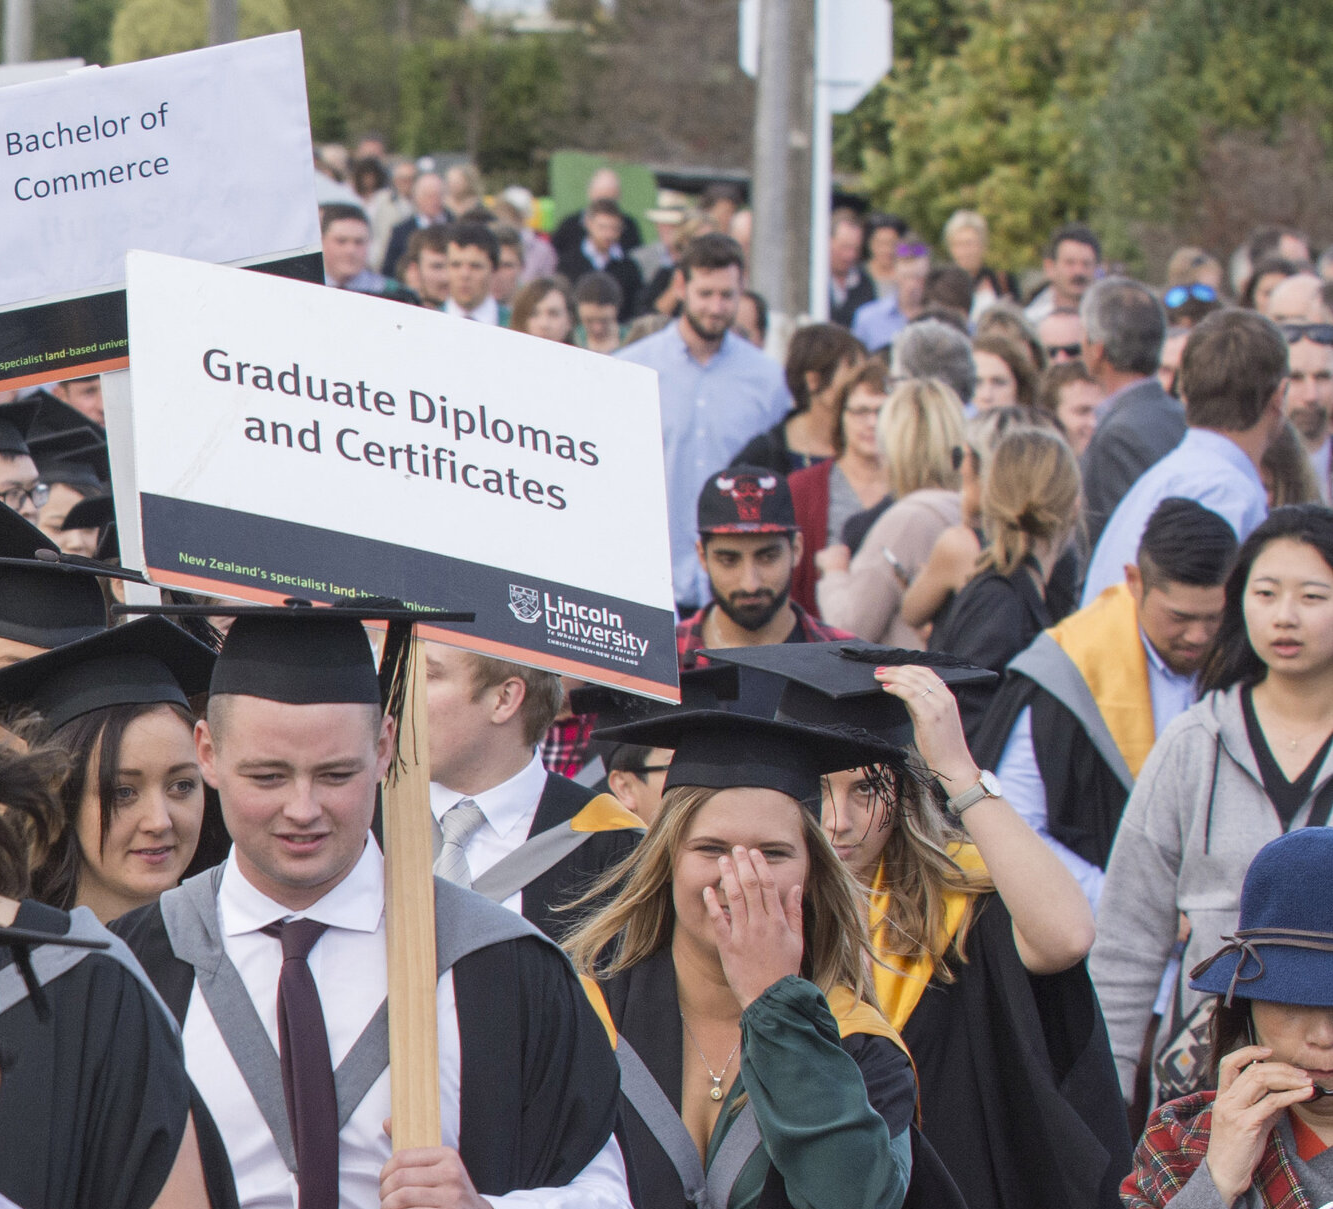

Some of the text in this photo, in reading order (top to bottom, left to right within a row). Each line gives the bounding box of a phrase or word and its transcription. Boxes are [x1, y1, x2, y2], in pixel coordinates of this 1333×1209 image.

[5, 102, 169, 157] Bachelor of
[14, 153, 170, 202] Commerce
[0, 354, 44, 371] specialist
[45, 343, 98, 361] land-based
[99, 338, 128, 351] univer
[202, 348, 600, 467] Graduate Diplomas
[244, 414, 567, 511] and Certificates
[178, 552, 206, 567] New
[209, 557, 267, 580] Zealand's
[270, 572, 326, 593] specialist
[544, 592, 622, 628] Lincoln
[545, 610, 649, 656] University
